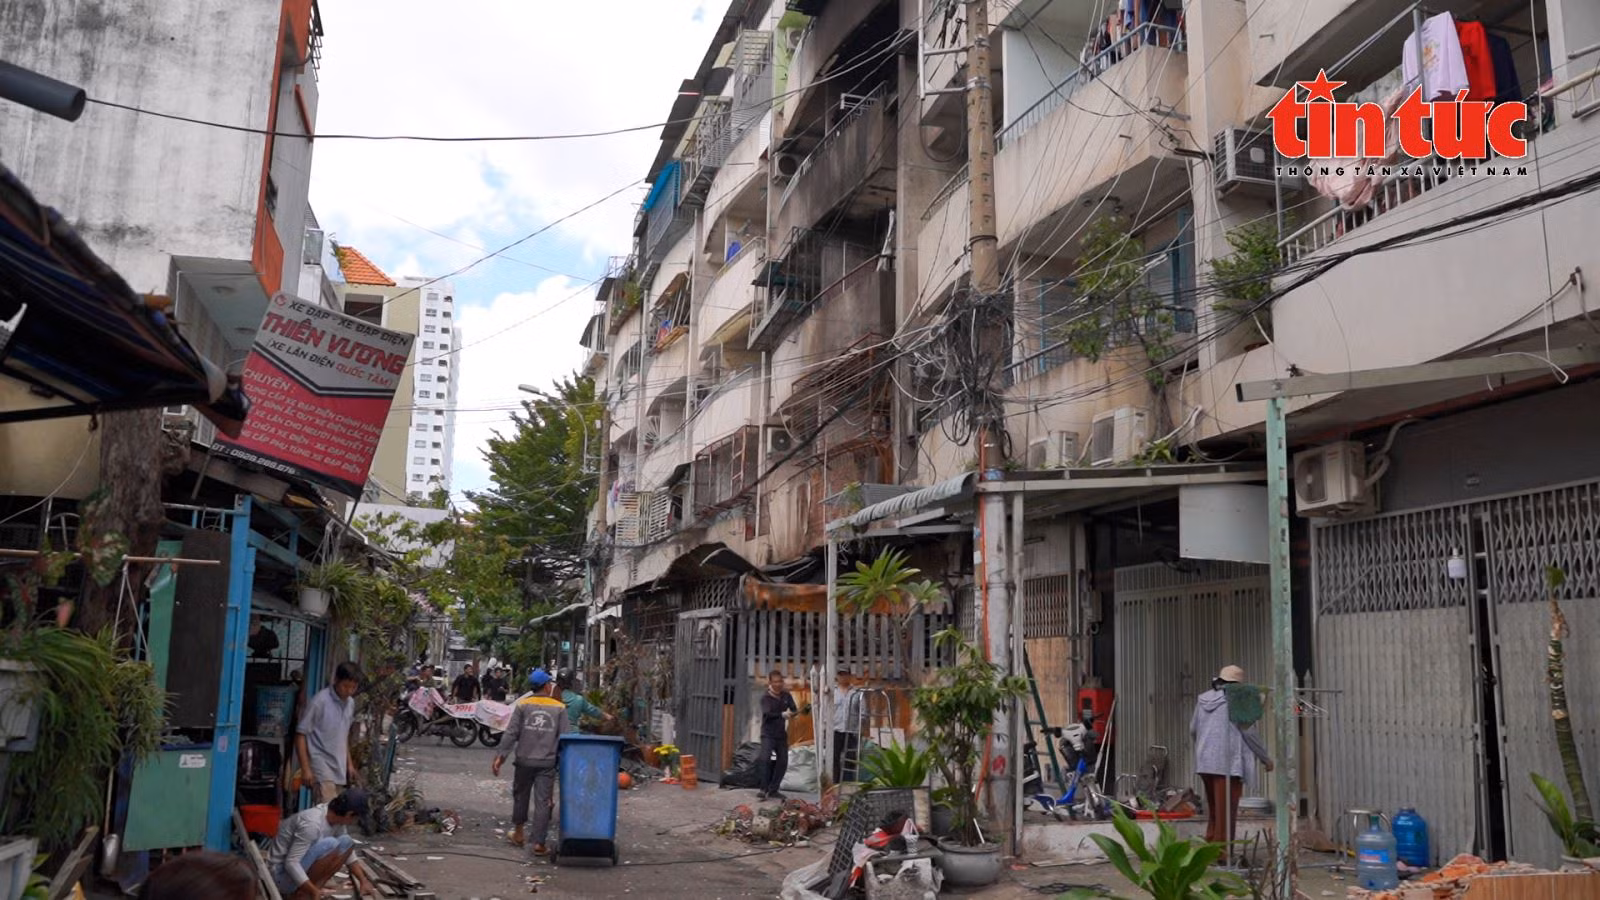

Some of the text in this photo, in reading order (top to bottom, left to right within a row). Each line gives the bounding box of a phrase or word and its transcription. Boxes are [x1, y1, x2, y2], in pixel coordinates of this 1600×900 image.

[289, 300, 306, 313] XE
[306, 307, 331, 320] ĐẠP
[337, 318, 354, 330] XE
[355, 323, 380, 336] ĐẠP
[380, 332, 409, 347] ĐIỆN
[262, 312, 408, 376] THIÊN VƯƠNG
[309, 353, 335, 369] ĐIỆN
[243, 369, 291, 391] CHUYÊN
